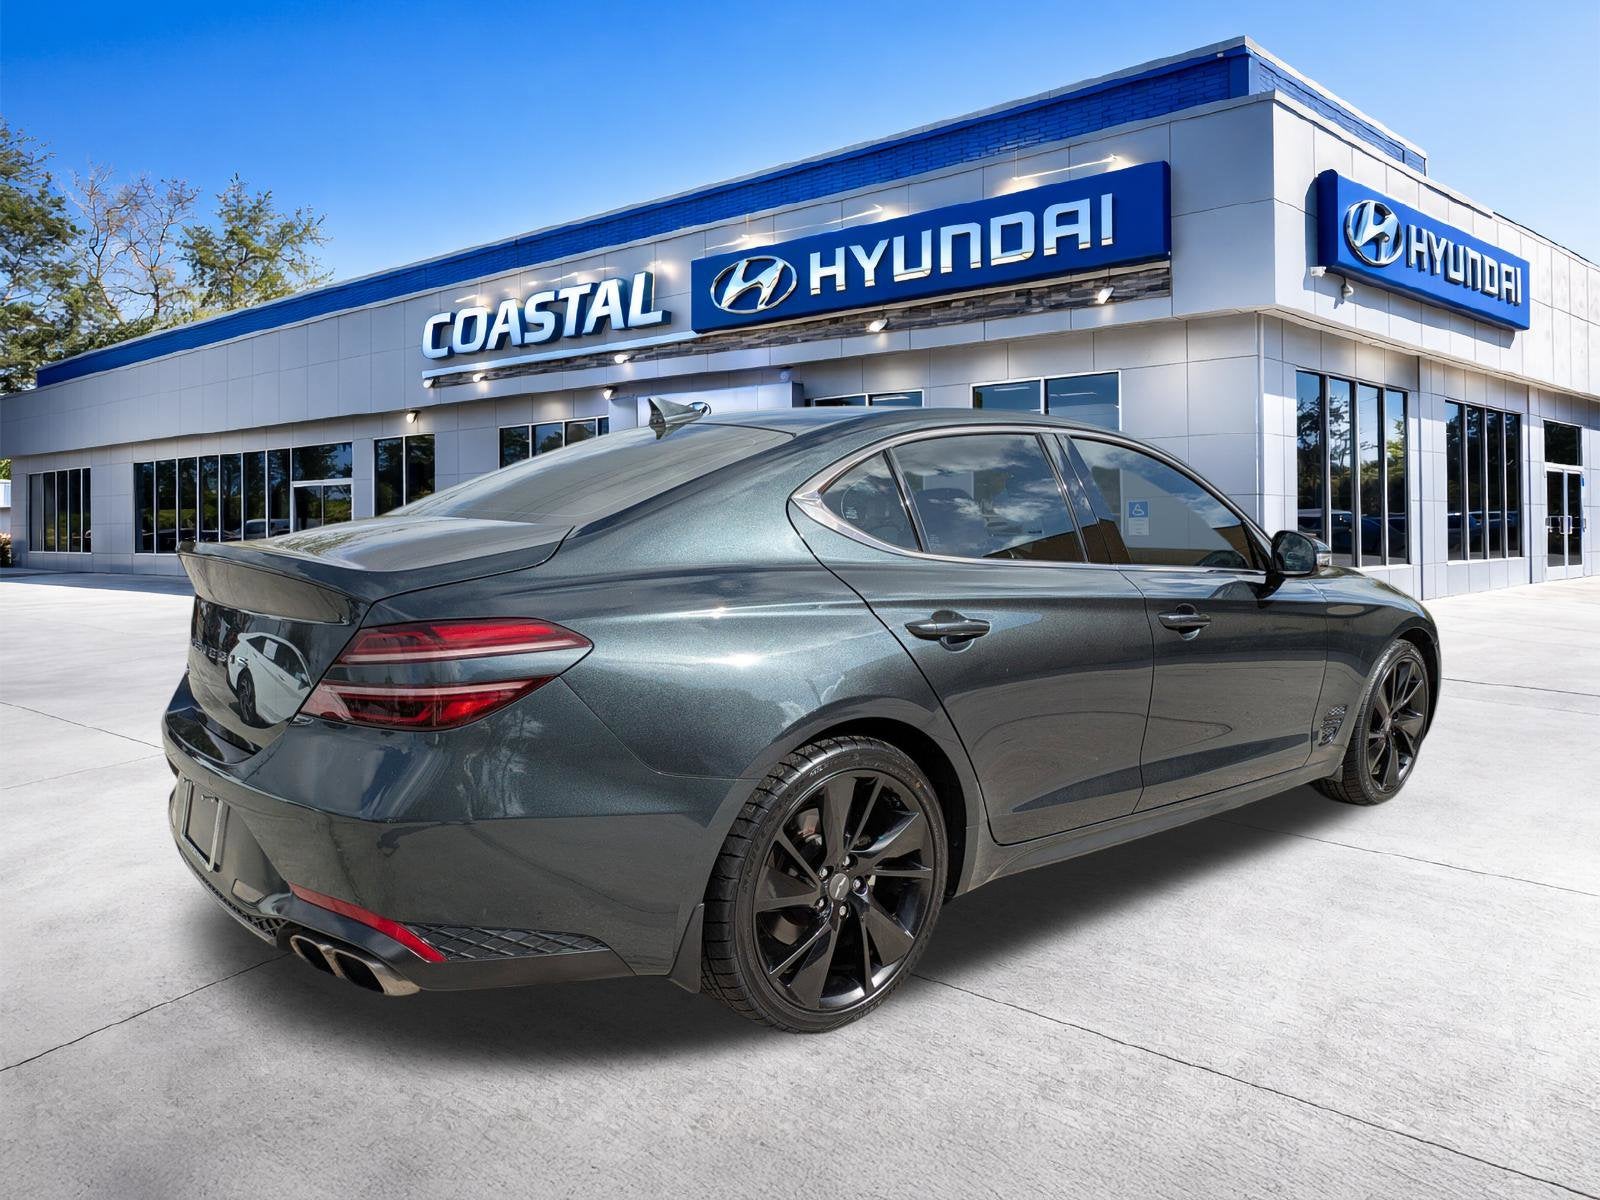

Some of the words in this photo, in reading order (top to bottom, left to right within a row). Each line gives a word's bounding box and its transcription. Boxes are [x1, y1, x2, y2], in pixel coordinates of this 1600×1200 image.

[809, 192, 1114, 296] HYUNDAI
[1406, 223, 1523, 306] HYUNDAI
[422, 271, 669, 360] COASTAL
